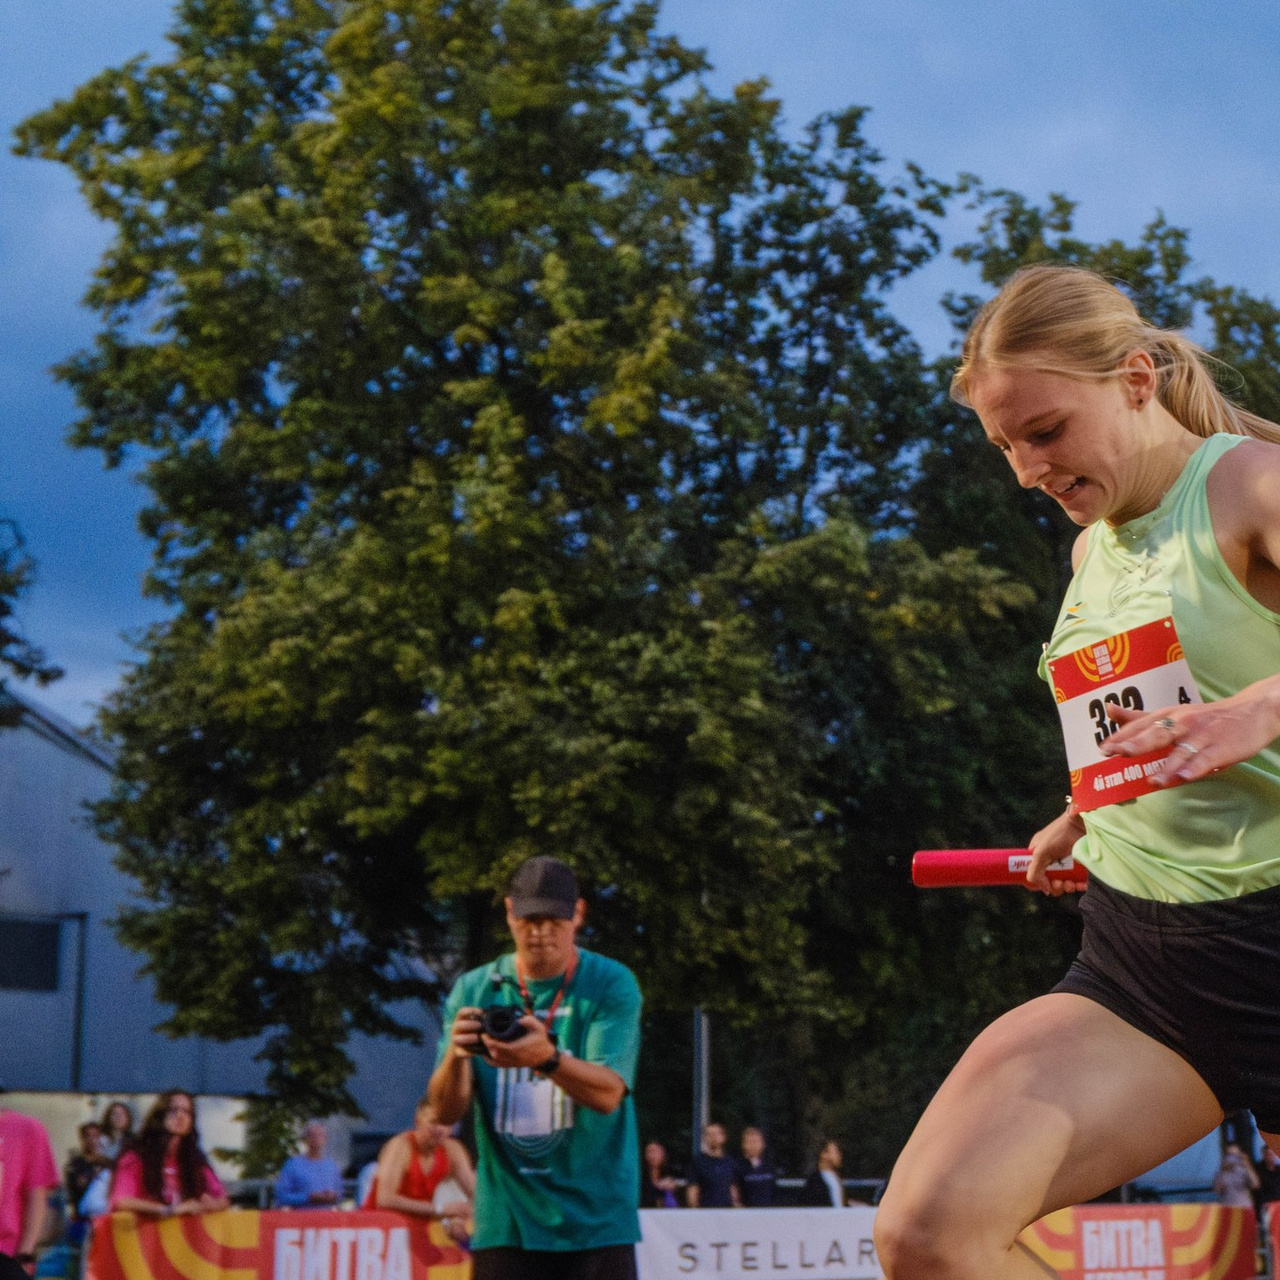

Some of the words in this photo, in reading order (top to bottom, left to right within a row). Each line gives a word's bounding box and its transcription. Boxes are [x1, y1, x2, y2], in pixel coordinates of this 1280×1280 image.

[1124, 764, 1143, 781] 400
[678, 1239, 875, 1273] STELLAR
[1083, 1220, 1165, 1269] БИТВА
